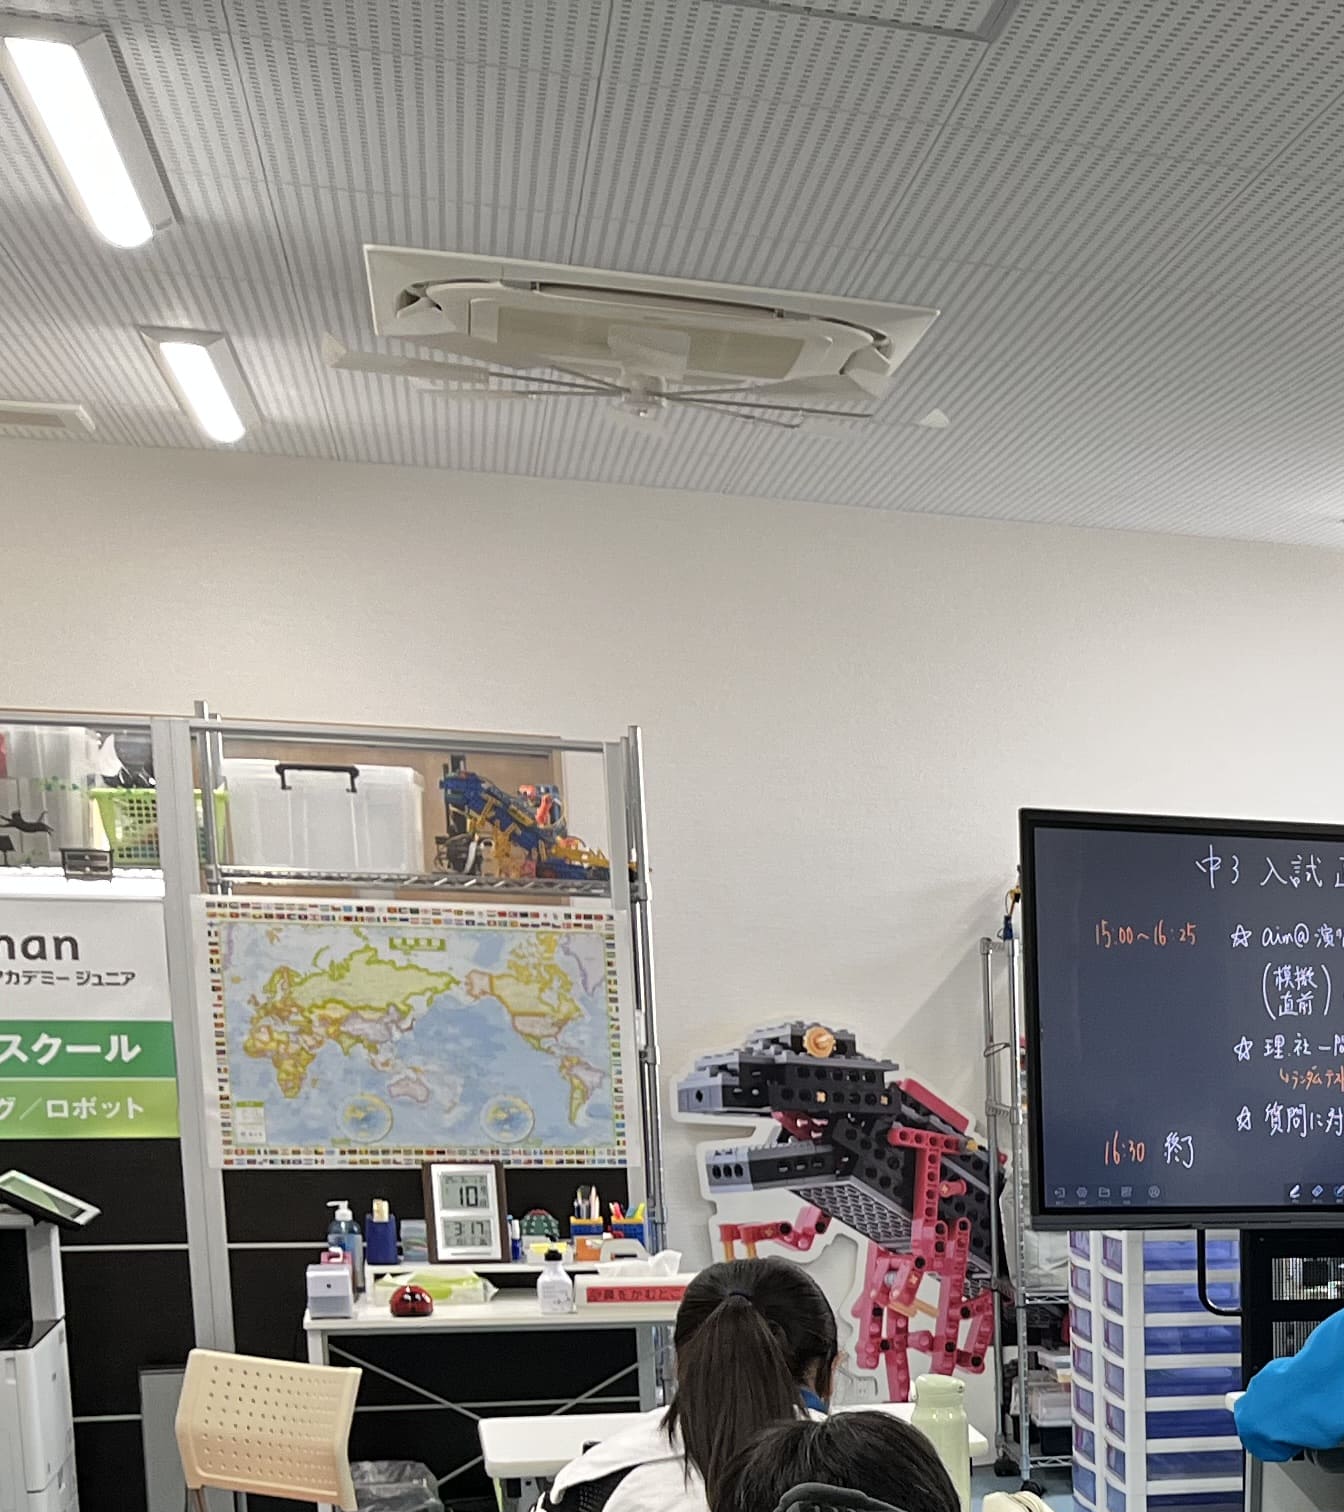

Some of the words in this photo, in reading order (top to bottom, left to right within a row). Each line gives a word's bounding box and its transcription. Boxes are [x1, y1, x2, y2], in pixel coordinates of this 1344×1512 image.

[0, 970, 70, 986] カデミー
[76, 970, 136, 987] ジュニア
[1104, 1130, 1146, 1166] 16:30
[459, 1186, 478, 1207] 10
